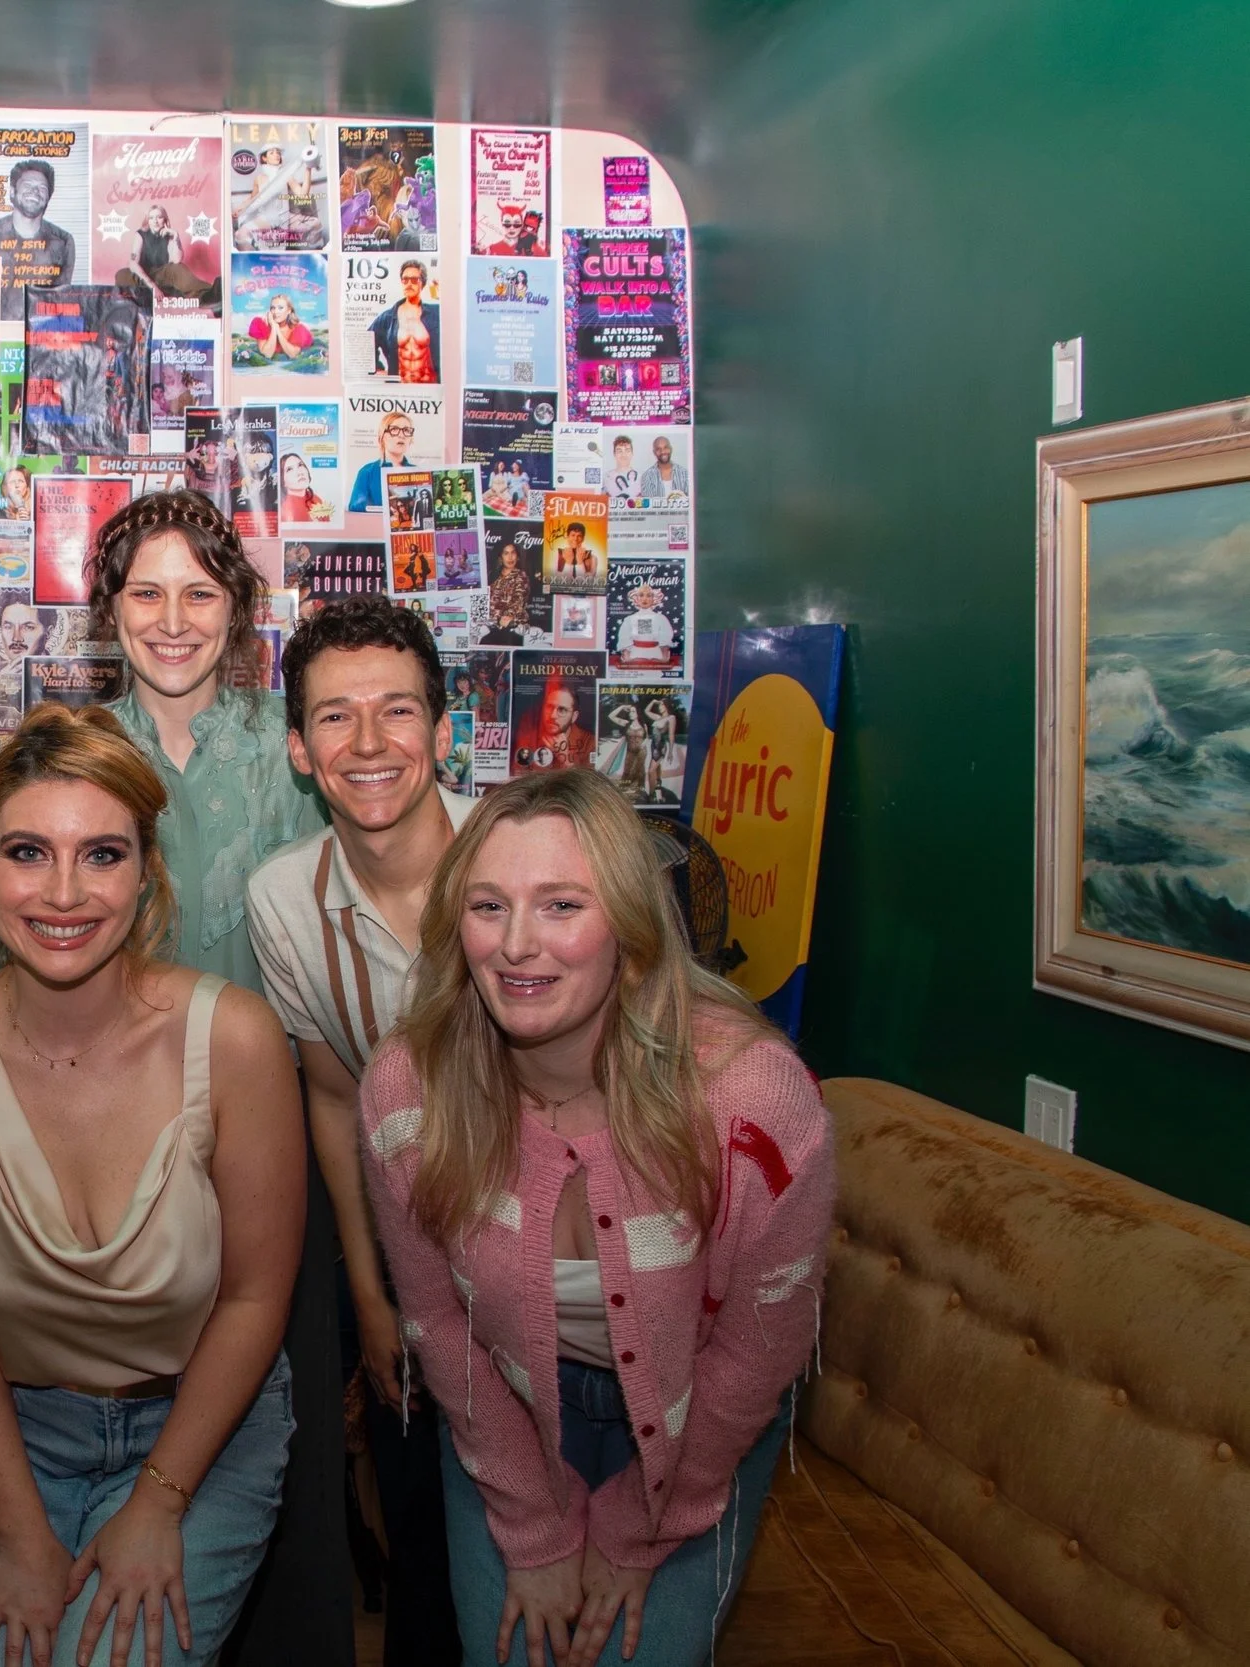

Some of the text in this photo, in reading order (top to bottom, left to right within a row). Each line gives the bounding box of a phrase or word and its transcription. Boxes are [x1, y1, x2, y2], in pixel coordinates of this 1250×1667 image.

[231, 123, 321, 143] LEAKY
[3, 145, 31, 156] CRIME
[32, 145, 71, 157] STORIES
[114, 137, 201, 170] Hannah
[606, 164, 647, 176] CULTS
[583, 228, 664, 239] SPECIAL TAPING
[600, 242, 650, 256] THREE
[14, 266, 61, 275] HYPERION
[249, 266, 311, 279] PLANET
[346, 257, 390, 279] 105
[583, 256, 664, 277] CULTS
[233, 277, 325, 298] COURTNEY
[345, 281, 383, 292] years
[581, 280, 626, 294] WALK
[658, 280, 671, 294] A
[161, 296, 200, 309] 9:30pm
[344, 292, 388, 305] young
[596, 295, 655, 317] BAR
[603, 326, 655, 335] SATURDAY
[593, 334, 615, 343] MAY
[0, 361, 17, 373] IS
[348, 397, 443, 414] VISIONARY
[463, 410, 529, 422] NIGHT PICNIC
[99, 460, 186, 472] CHLOE RADCLI
[38, 486, 64, 496] THE
[39, 495, 75, 504] LYRIC
[39, 505, 98, 514] SESSIONS
[547, 495, 607, 519] FLAYED
[315, 555, 382, 572] FUNERAL
[608, 565, 658, 581] Medicine
[313, 576, 382, 594] BOUQUET
[632, 574, 680, 587] Woman
[30, 663, 118, 680] Kyle Ayers
[519, 663, 599, 677] HARD TO SAY
[42, 677, 107, 690] Hard to Say
[730, 707, 751, 747] the
[474, 727, 509, 750] GIRL
[702, 735, 793, 836] Lyric
[720, 856, 779, 919] ERION
